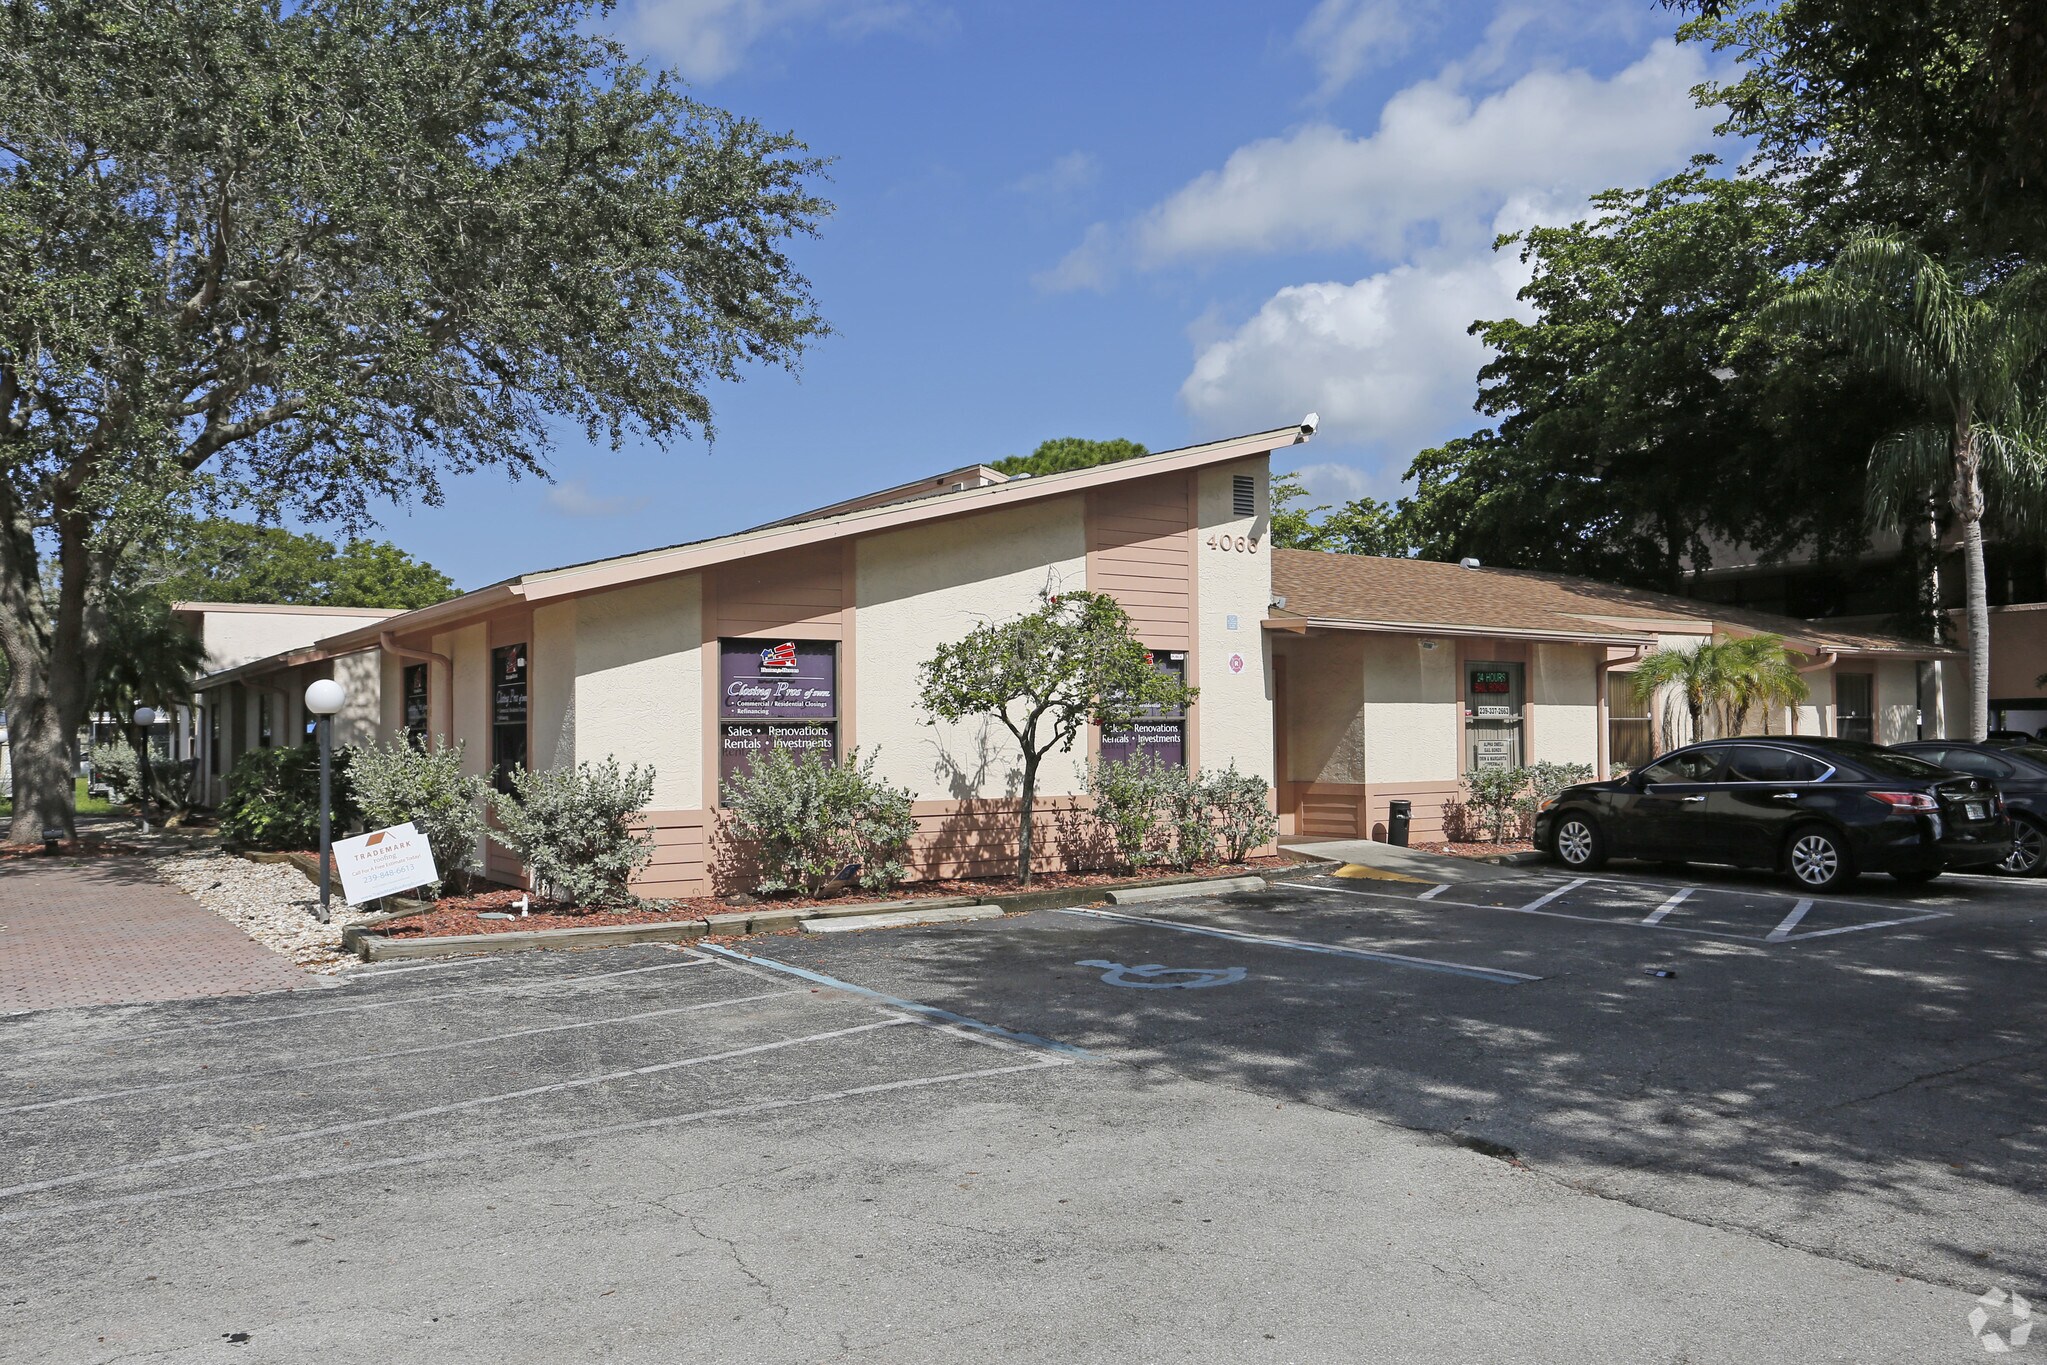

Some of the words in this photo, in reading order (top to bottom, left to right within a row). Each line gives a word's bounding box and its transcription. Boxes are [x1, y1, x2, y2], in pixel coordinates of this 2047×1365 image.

[1477, 672, 1484, 682] 24
[1486, 672, 1506, 682] HOURS
[728, 681, 771, 700] Closing
[773, 682, 802, 697] Pros
[804, 688, 814, 699] of
[728, 726, 753, 736] Sales
[768, 726, 829, 736] Renovations
[1134, 723, 1178, 733] Renovations
[1138, 734, 1181, 743] Investments
[724, 739, 761, 749] Rentals
[773, 739, 832, 749] Investments
[354, 841, 412, 861] TRADEMARK
[373, 853, 397, 863] roofing
[363, 864, 415, 884] 239-848-6613
